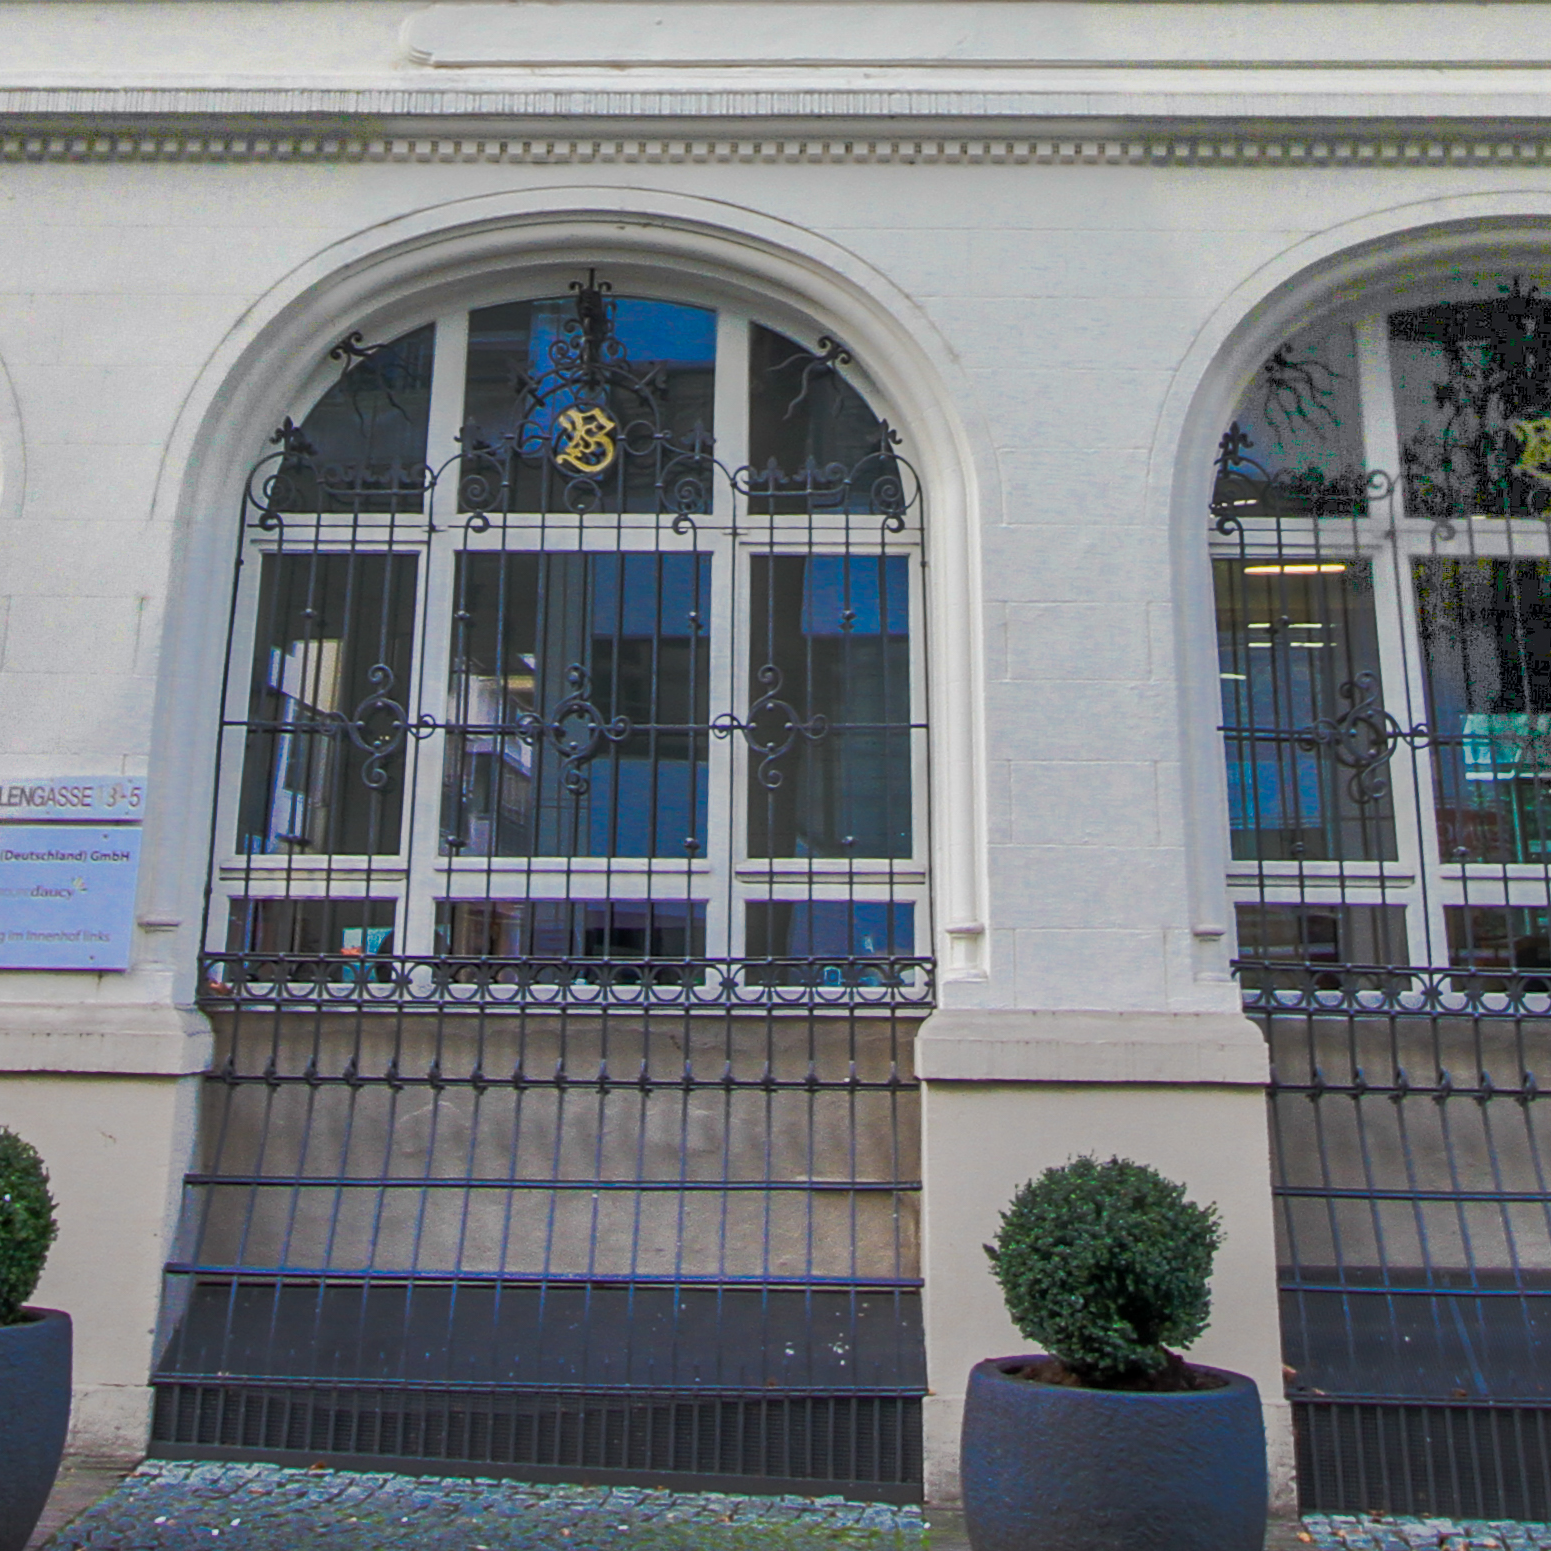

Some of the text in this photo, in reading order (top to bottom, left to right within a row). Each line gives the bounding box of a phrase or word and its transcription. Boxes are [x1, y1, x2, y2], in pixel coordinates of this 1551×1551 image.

[0, 850, 87, 862] (Deutschland)
[90, 850, 130, 861] GmbH
[26, 929, 82, 942] Innenhof
[84, 929, 111, 942] links
